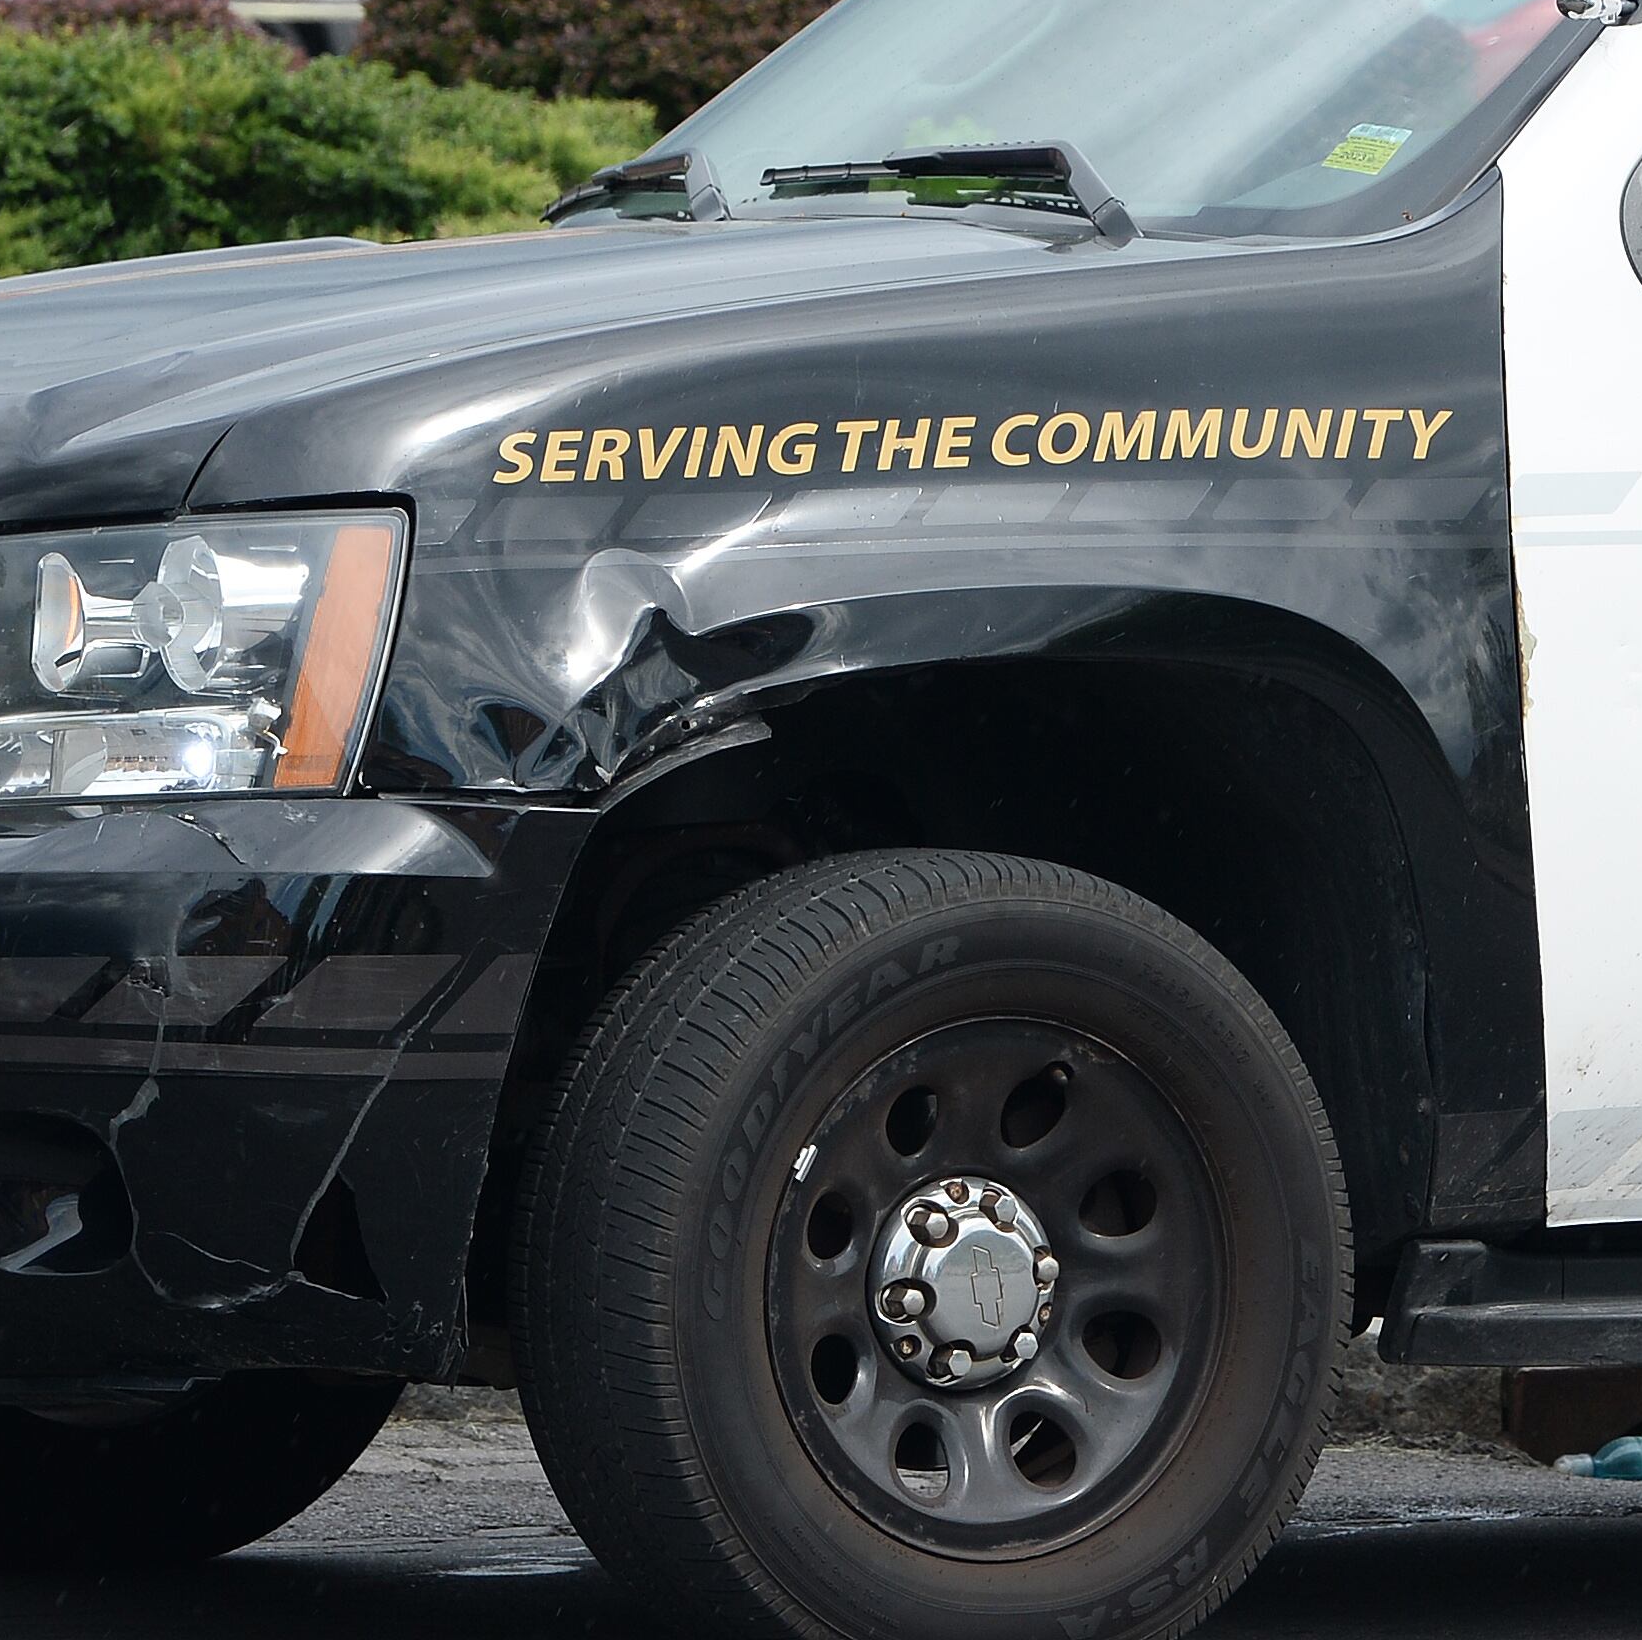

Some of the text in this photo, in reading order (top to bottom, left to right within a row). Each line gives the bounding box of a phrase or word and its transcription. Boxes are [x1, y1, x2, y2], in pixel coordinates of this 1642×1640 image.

[491, 407, 1455, 486] SERVING THE COMMUNITY
[701, 934, 961, 1323] GOODYEAR
[1239, 1240, 1324, 1518] EAGLE
